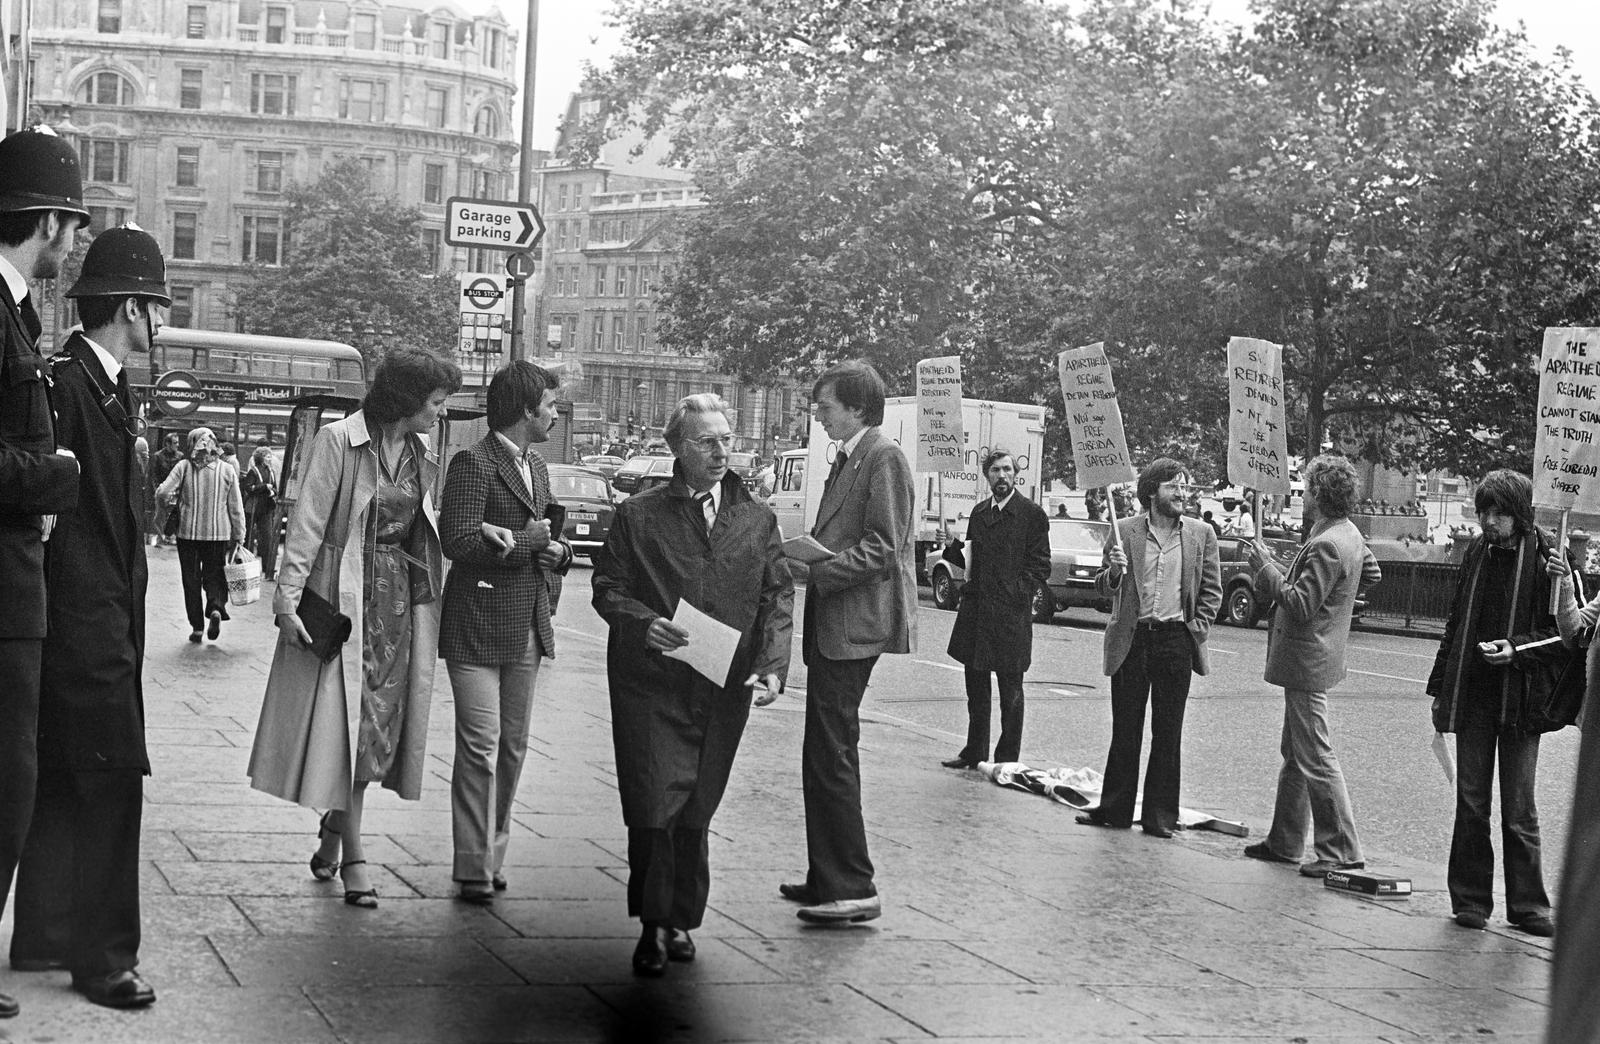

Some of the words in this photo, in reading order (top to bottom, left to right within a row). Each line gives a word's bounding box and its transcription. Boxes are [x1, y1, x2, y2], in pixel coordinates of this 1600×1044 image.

[459, 208, 512, 226] Garage
[457, 225, 511, 242] parking
[468, 289, 482, 297] BUS
[483, 290, 500, 298] STOP
[463, 341, 472, 349] 29
[1566, 341, 1587, 357] THE
[1065, 356, 1107, 371] APARTHEID
[151, 389, 206, 400] UNDERGROUND
[1557, 381, 1597, 400] REGIME
[1541, 406, 1578, 419] CANNOT
[1083, 425, 1104, 438] FREE
[1544, 424, 1559, 437] THE
[1561, 426, 1593, 443] TRUTH
[1084, 452, 1125, 468] JAFFER!
[1326, 871, 1350, 887] Croxley
